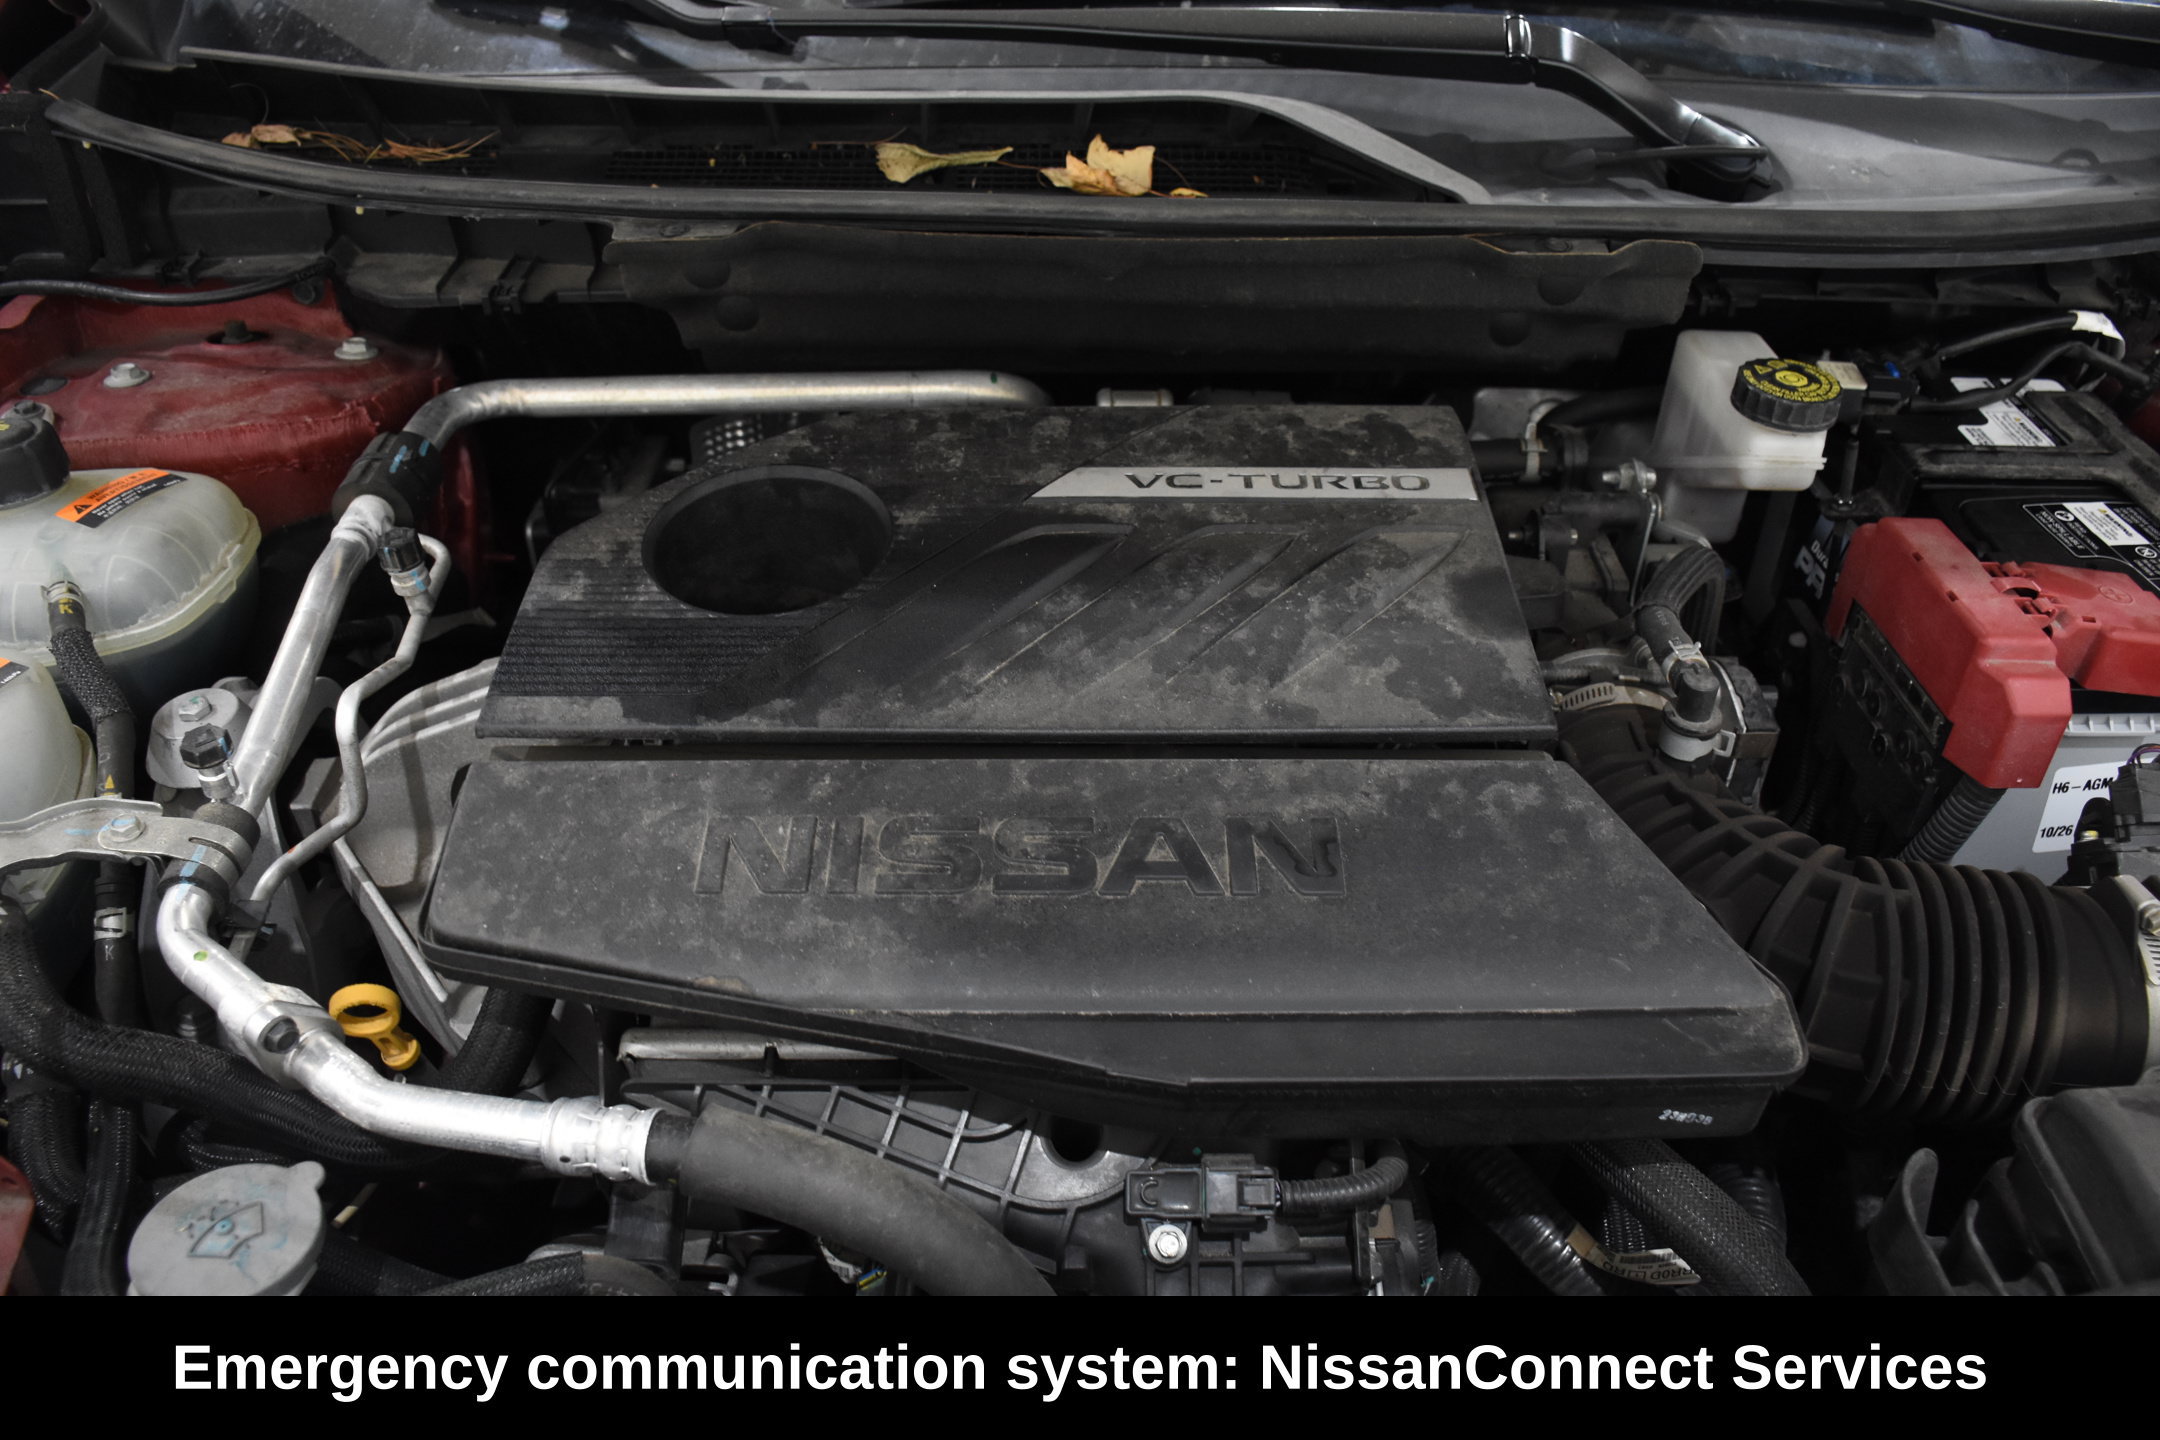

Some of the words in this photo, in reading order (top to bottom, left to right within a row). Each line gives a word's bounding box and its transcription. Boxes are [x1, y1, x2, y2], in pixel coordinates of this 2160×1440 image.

[1124, 473, 1431, 491] VC-TURBO
[2040, 825, 2074, 839] 10/26
[694, 816, 1347, 898] NISSAN
